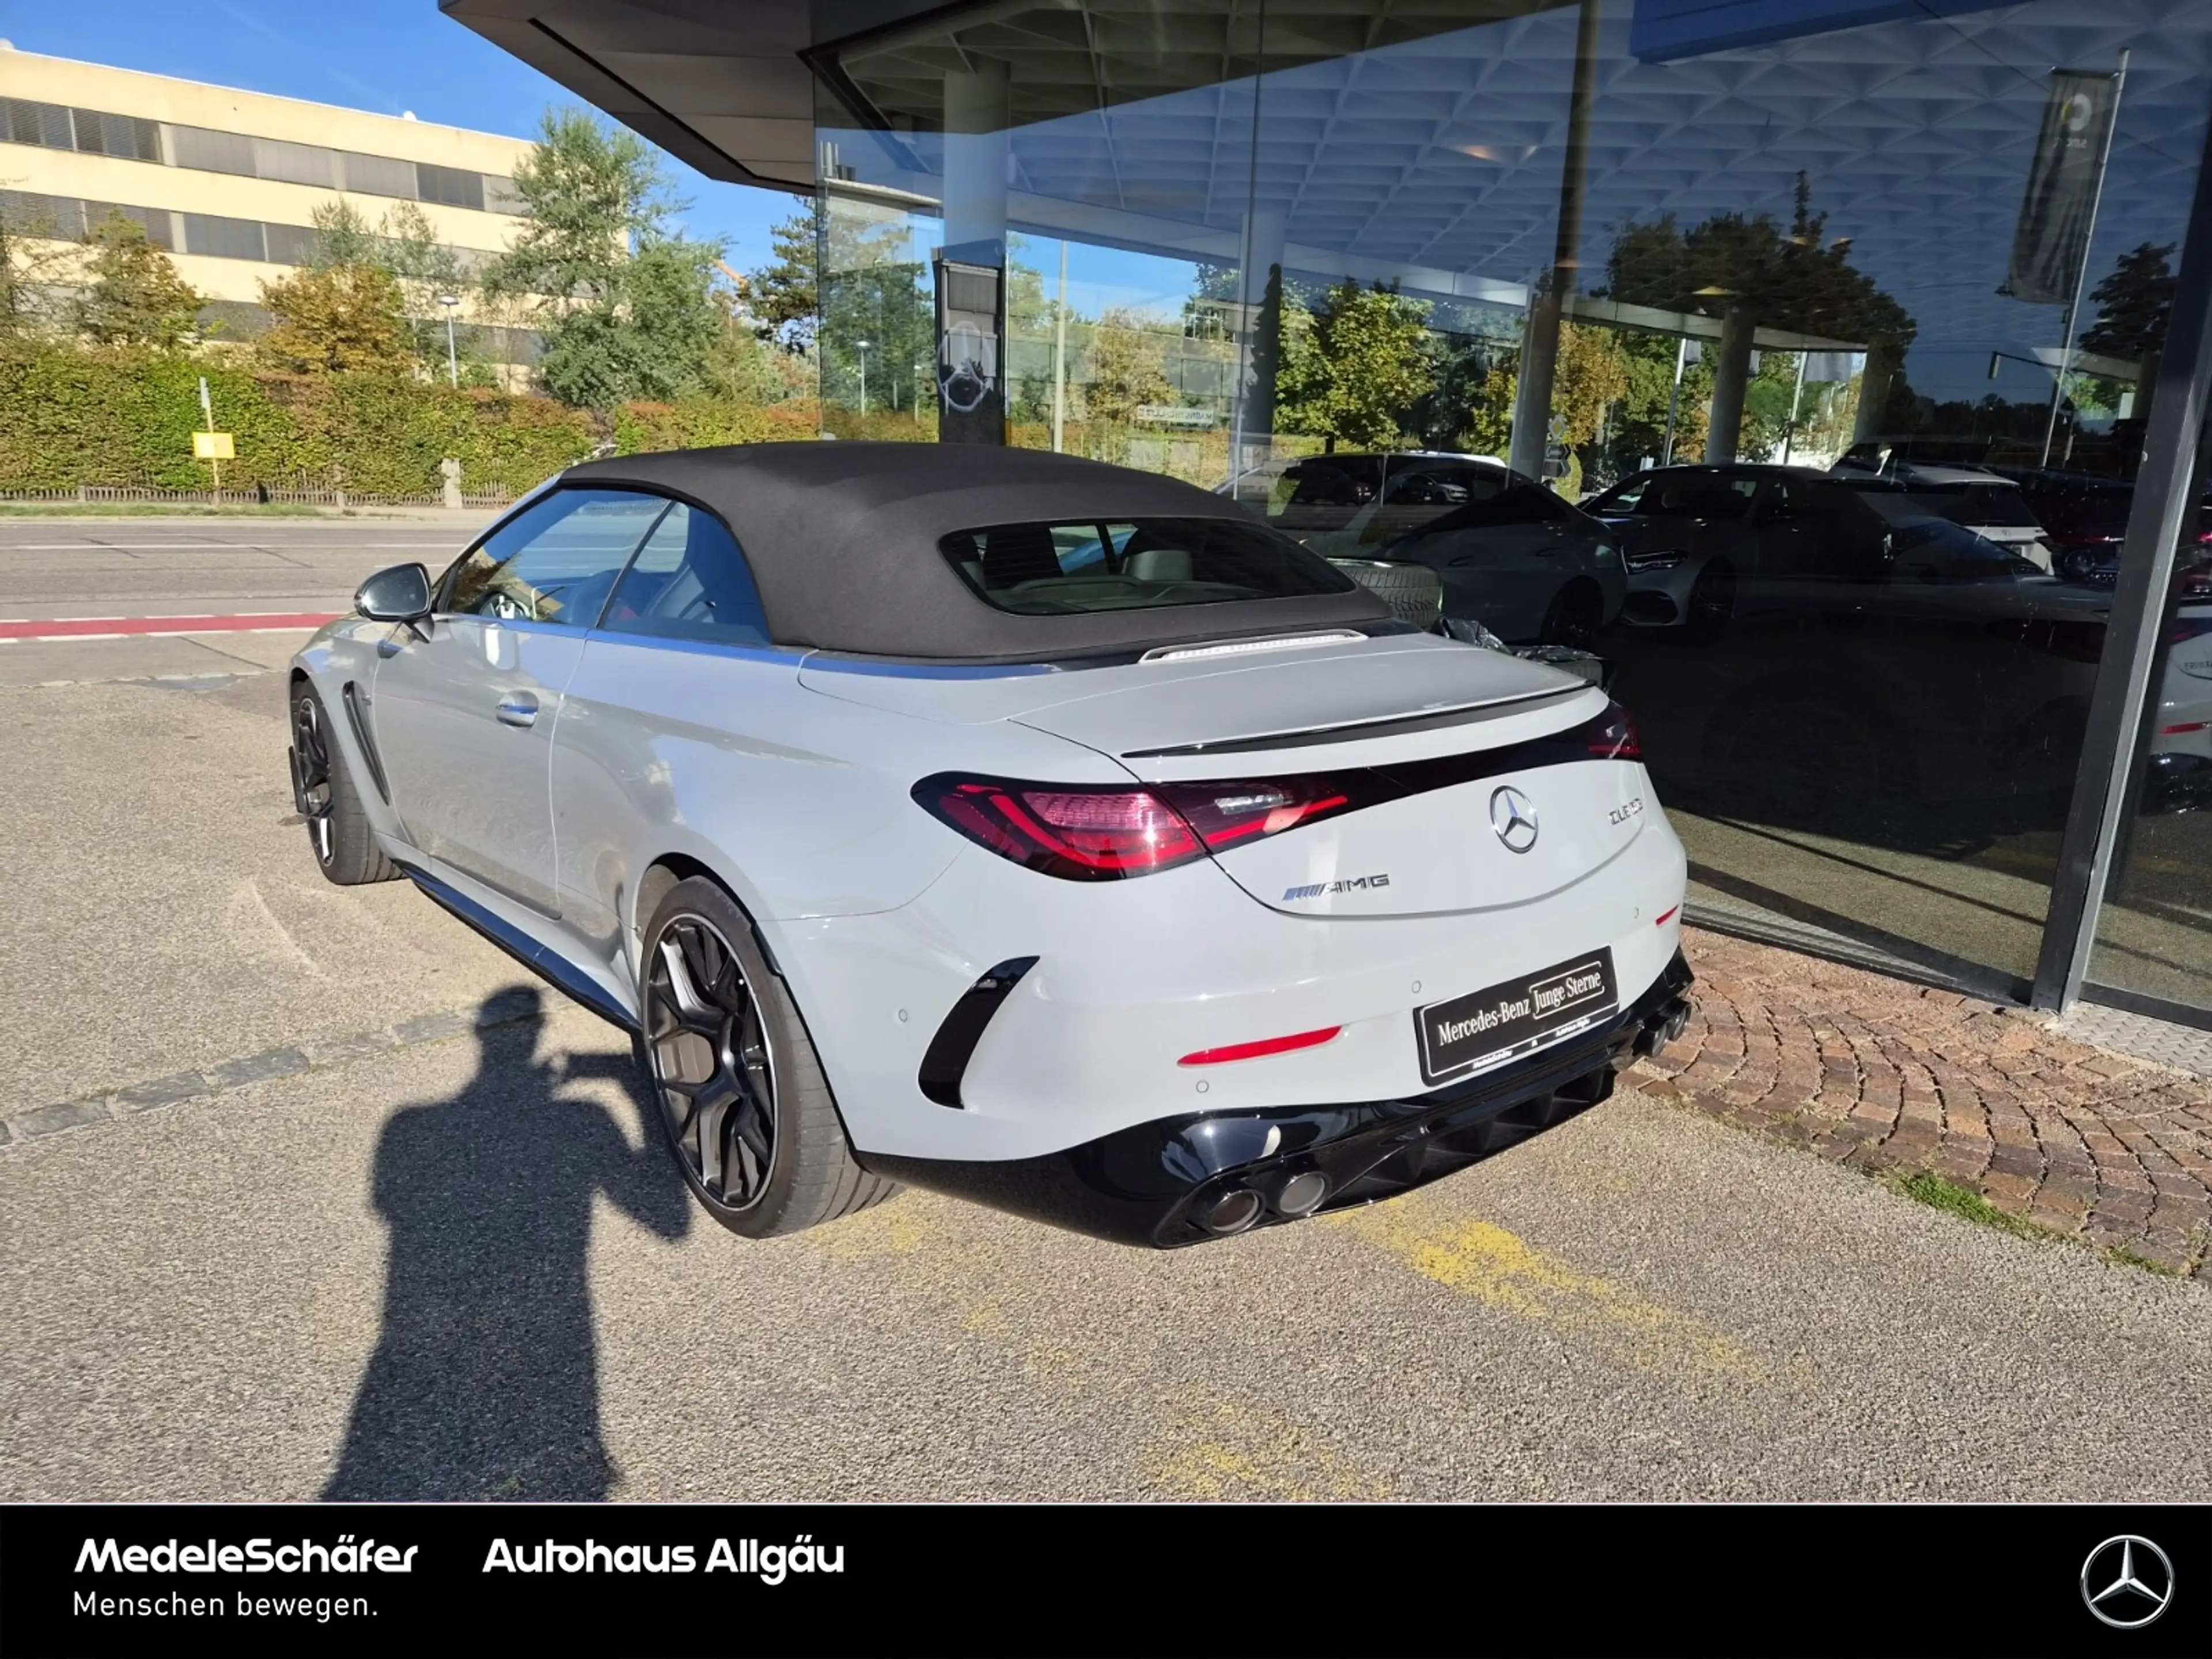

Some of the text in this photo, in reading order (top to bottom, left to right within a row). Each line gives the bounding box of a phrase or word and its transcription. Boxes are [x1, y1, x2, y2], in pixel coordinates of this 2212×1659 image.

[1438, 998, 1531, 1046] Mercedes-Benz
[1534, 986, 1565, 1013] Junge
[1566, 971, 1601, 997] Sterne
